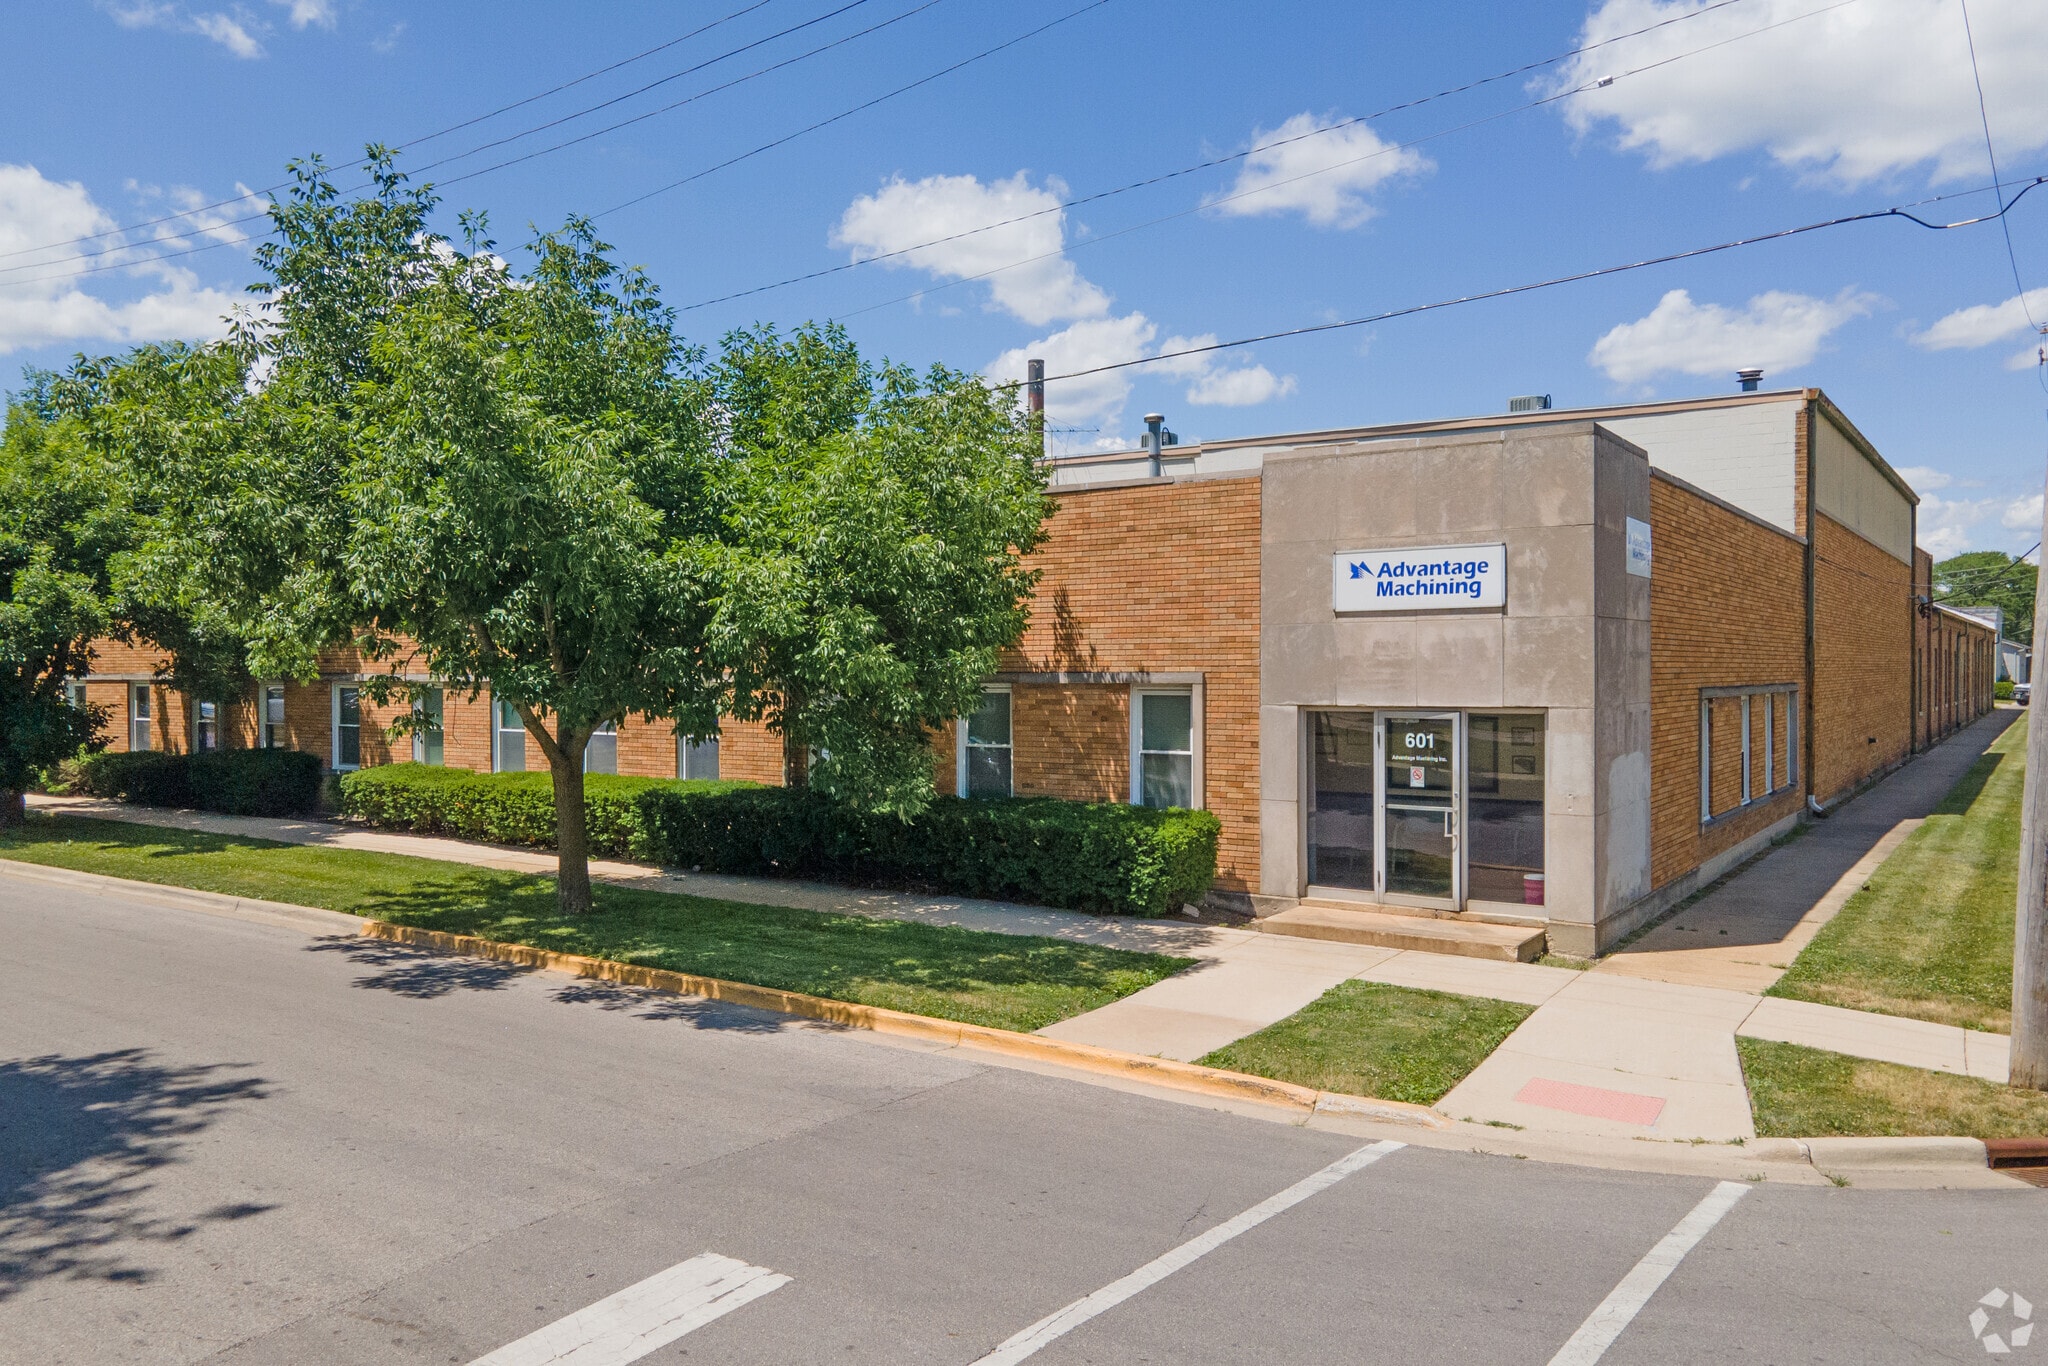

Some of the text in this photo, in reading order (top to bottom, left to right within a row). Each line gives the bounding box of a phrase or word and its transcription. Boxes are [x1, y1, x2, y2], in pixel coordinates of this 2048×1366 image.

[1376, 560, 1489, 579] Advantage
[1376, 579, 1482, 598] Machining
[1405, 733, 1434, 748] 601
